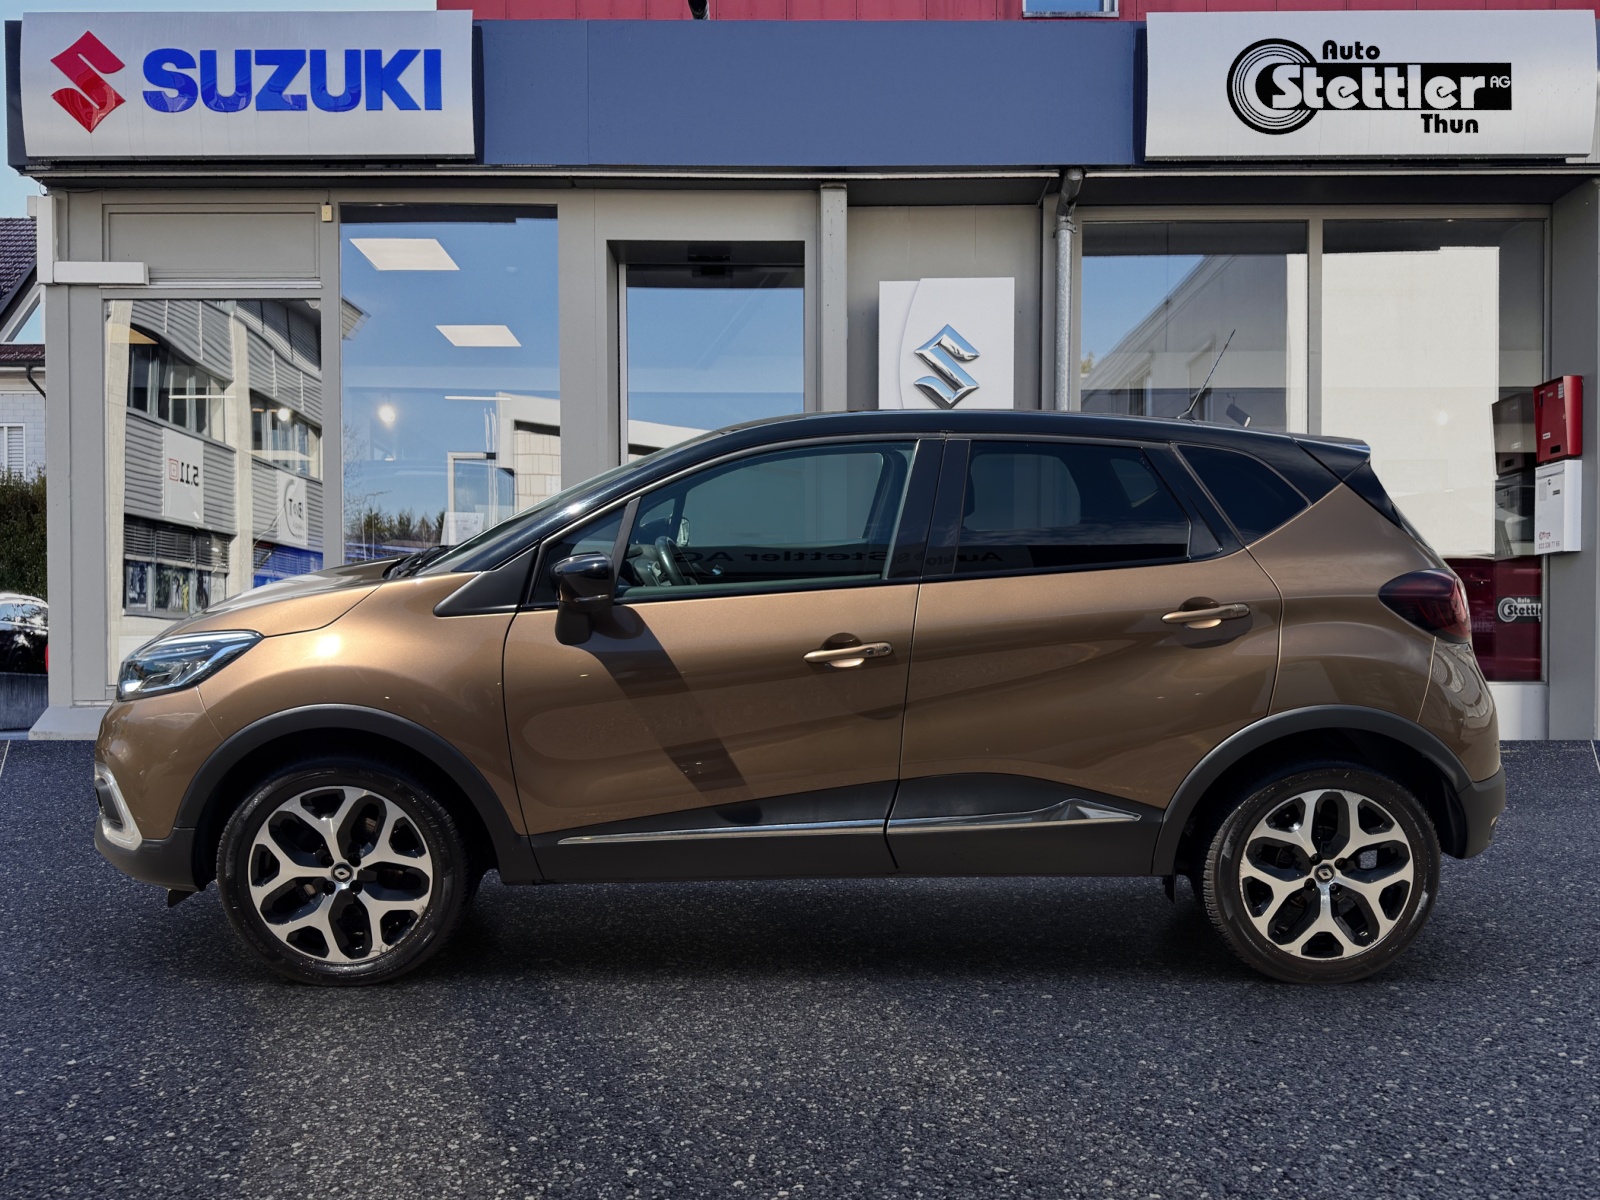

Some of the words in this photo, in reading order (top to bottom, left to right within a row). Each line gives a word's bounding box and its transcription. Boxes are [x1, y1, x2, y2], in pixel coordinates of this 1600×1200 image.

[1323, 40, 1381, 60] Auto
[143, 48, 442, 113] SUZUKI
[1272, 63, 1486, 109] Stettler
[1490, 76, 1511, 88] AG
[1421, 113, 1479, 133] Thun
